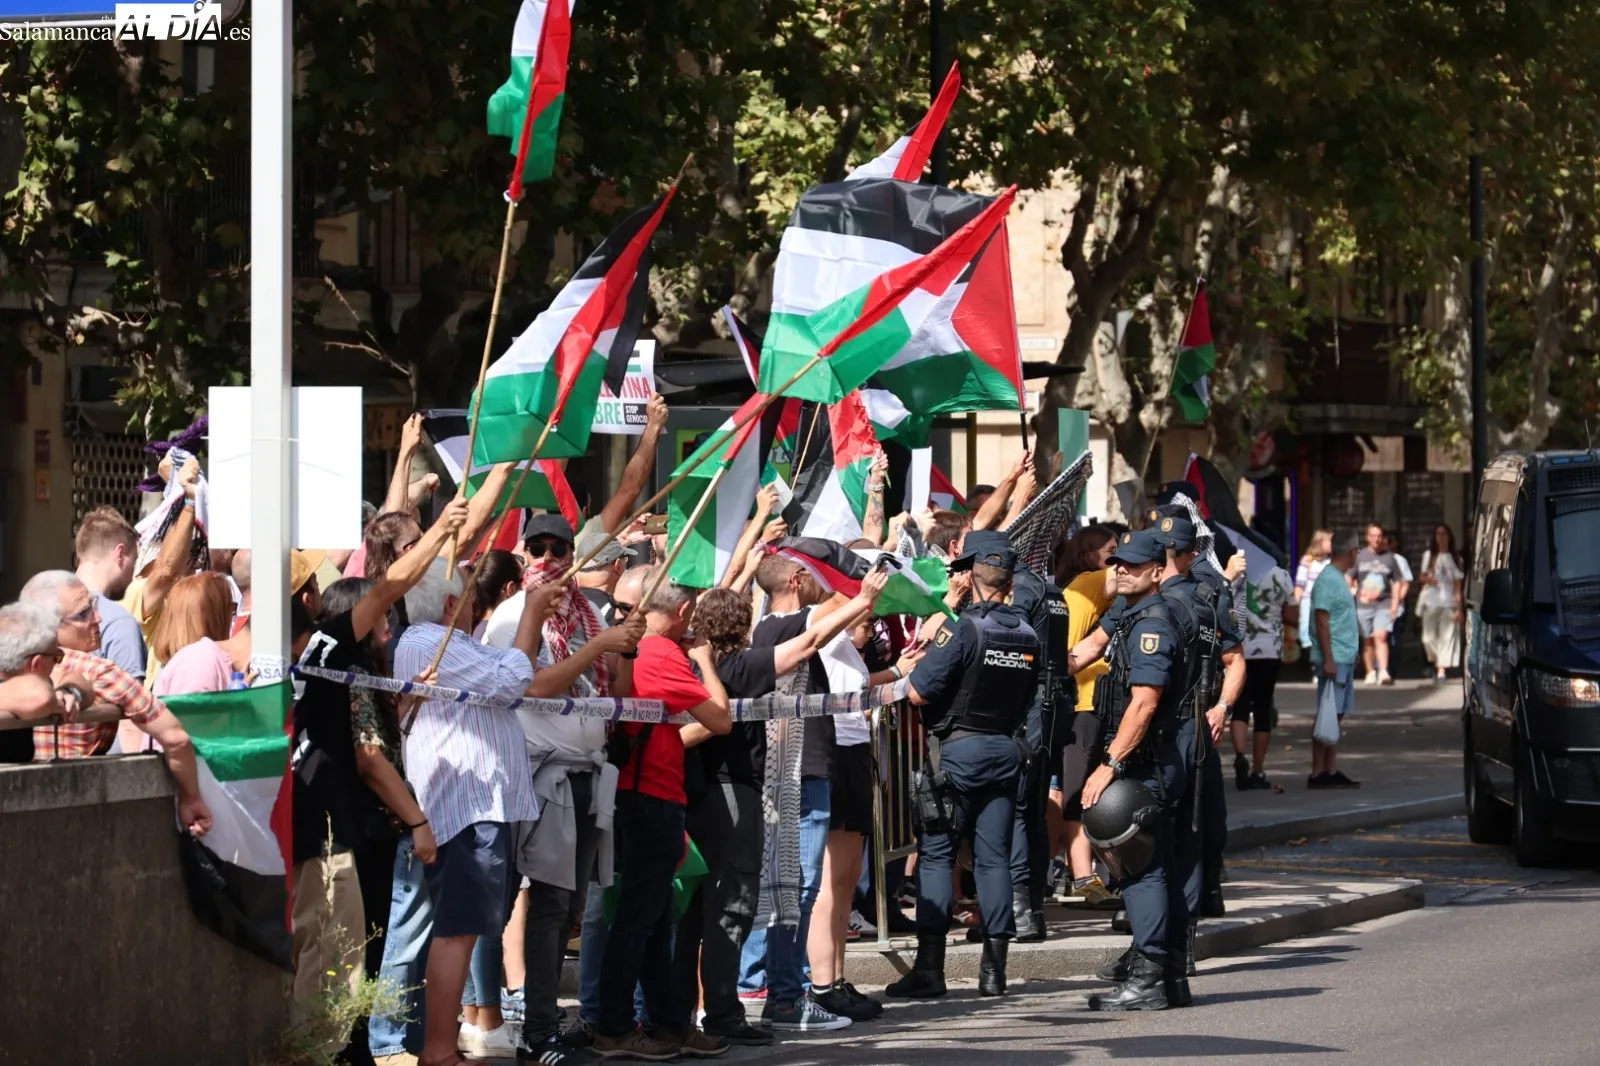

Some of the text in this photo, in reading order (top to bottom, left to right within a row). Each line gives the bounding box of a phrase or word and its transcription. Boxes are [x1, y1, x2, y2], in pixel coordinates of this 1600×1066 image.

[593, 402, 622, 425] BRE
[625, 405, 638, 414] STOP
[1199, 625, 1214, 636] POLIC
[985, 650, 1025, 661] POLICIA
[983, 658, 1032, 670] NACIONAL
[638, 710, 645, 721] NO
[645, 710, 661, 722] PASAR
